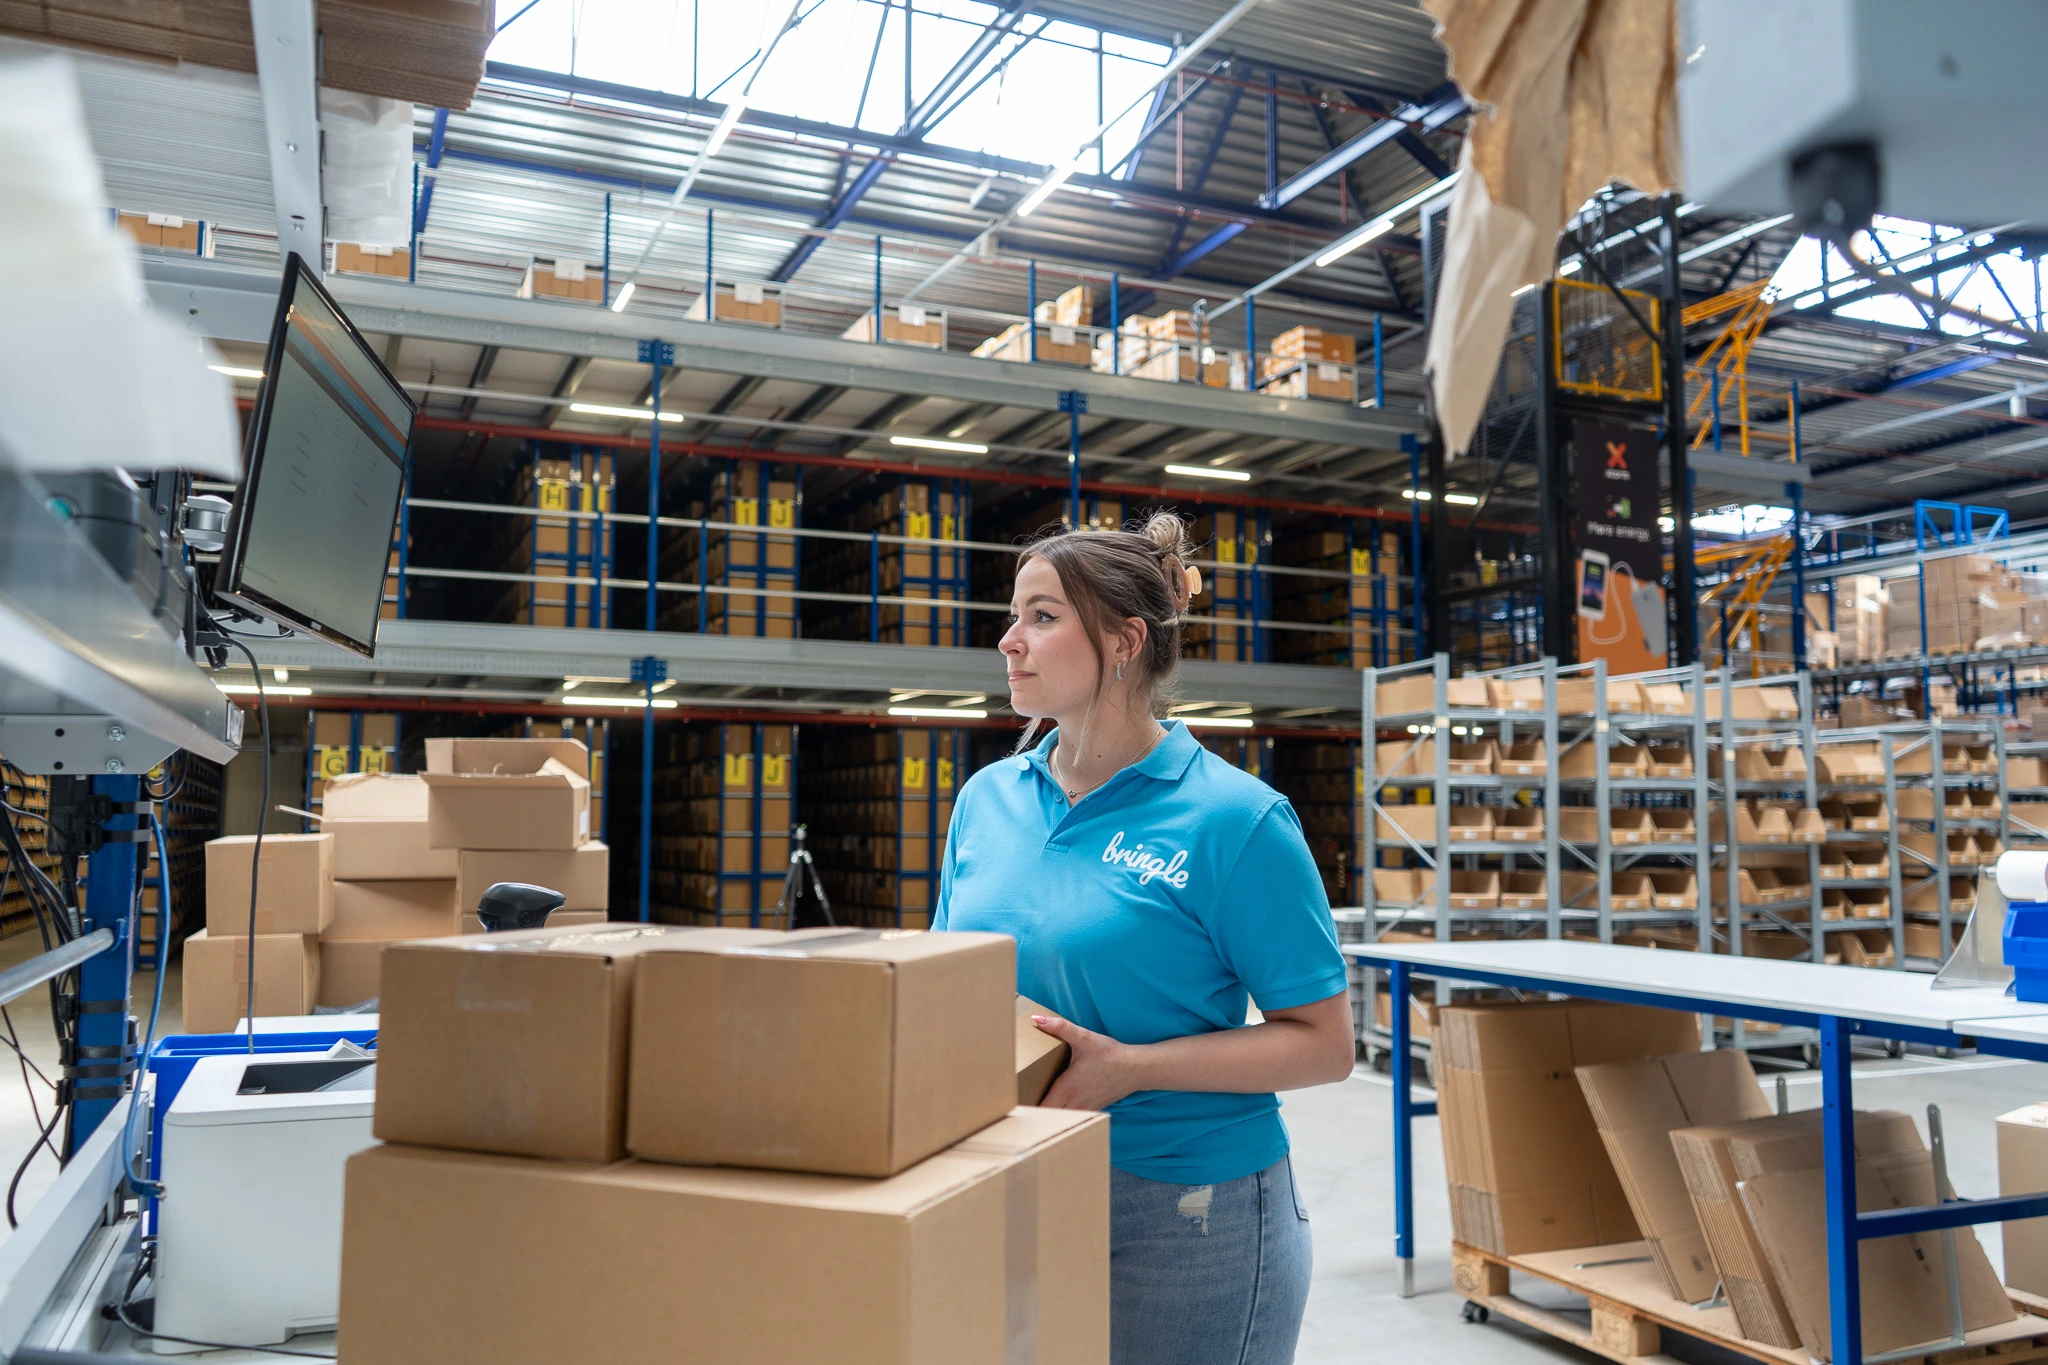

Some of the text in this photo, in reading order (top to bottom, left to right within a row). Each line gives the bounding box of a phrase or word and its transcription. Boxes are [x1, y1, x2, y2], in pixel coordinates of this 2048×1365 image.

[546, 489, 561, 506] H
[775, 506, 787, 525] J
[913, 519, 925, 538] J
[326, 753, 345, 776] G
[366, 756, 383, 773] H
[767, 763, 779, 782] J
[907, 766, 920, 785] J
[941, 766, 955, 784] K
[1101, 830, 1190, 889] bringle
